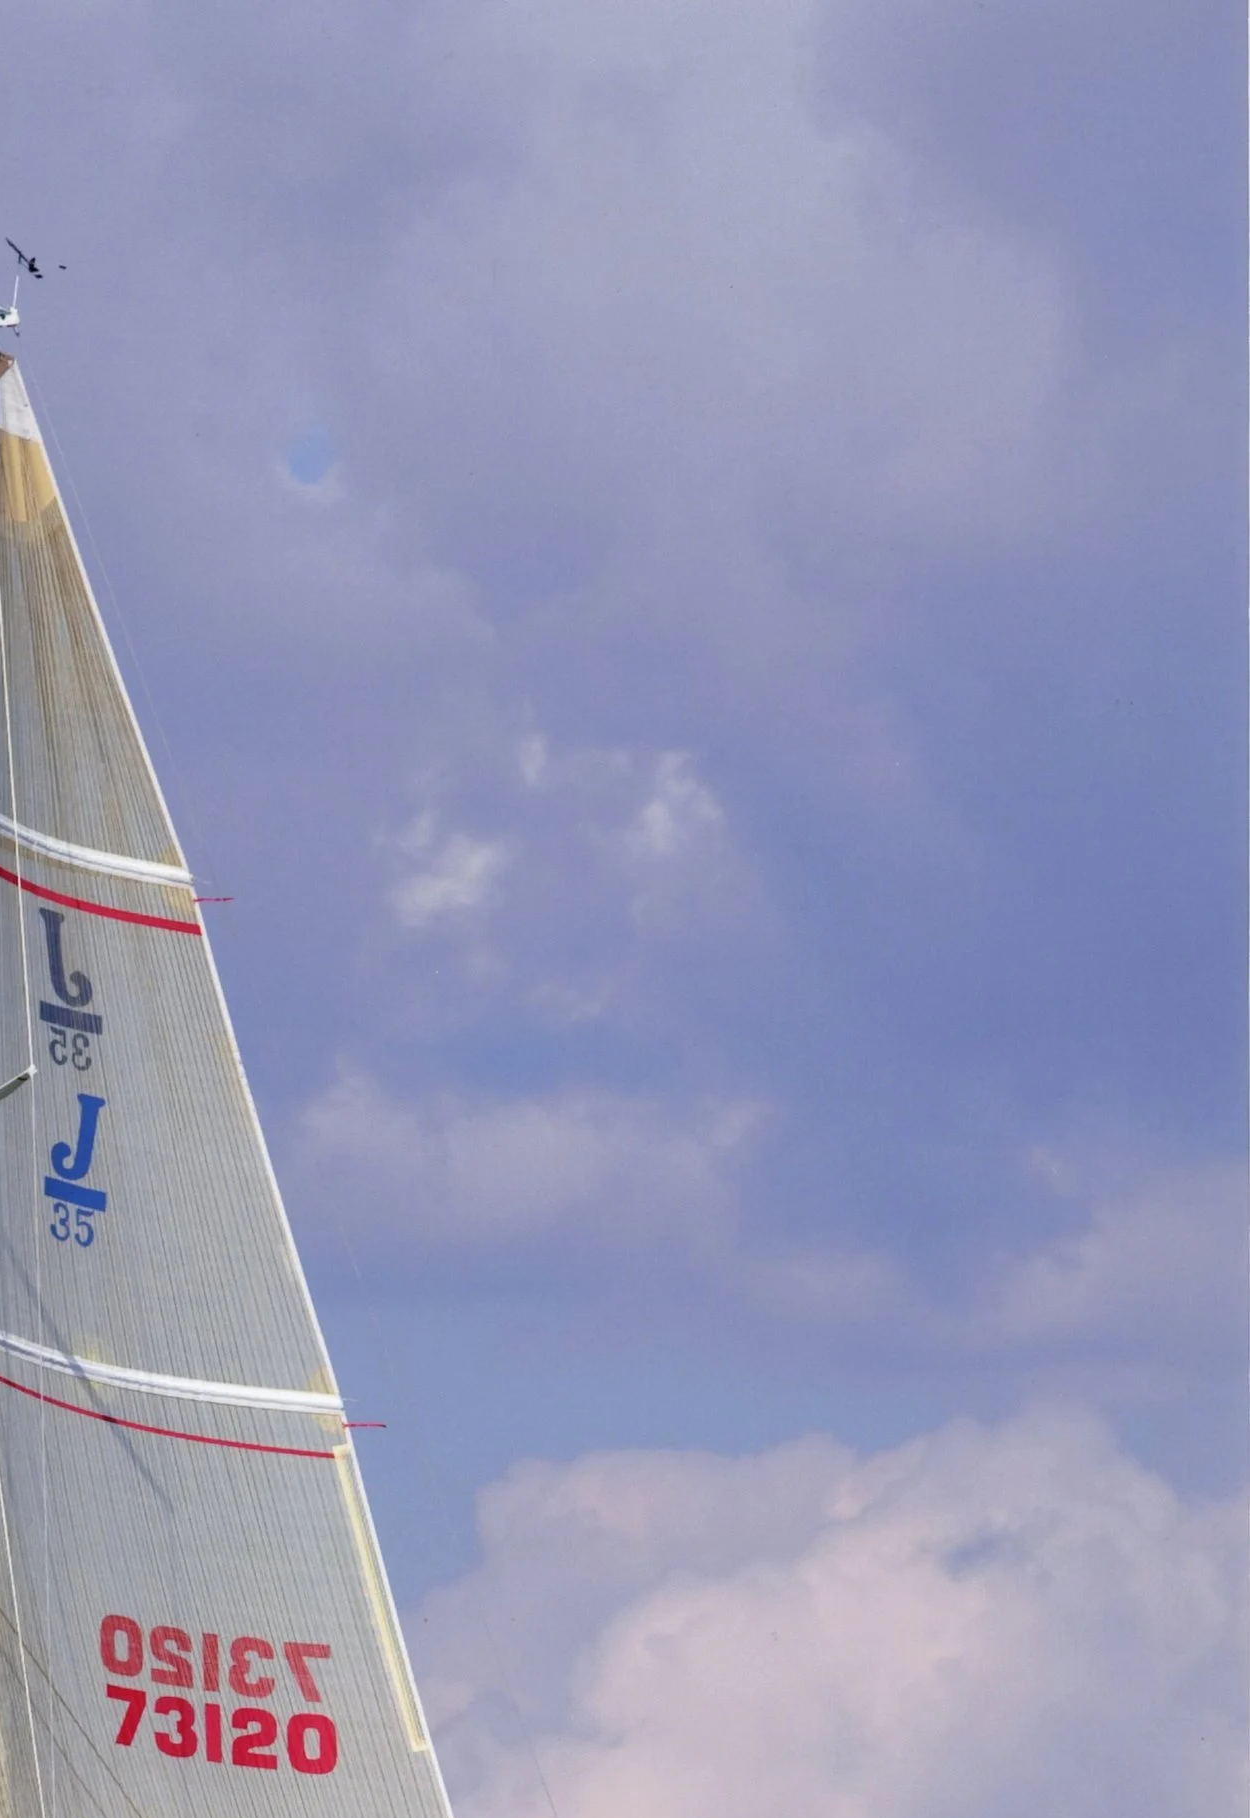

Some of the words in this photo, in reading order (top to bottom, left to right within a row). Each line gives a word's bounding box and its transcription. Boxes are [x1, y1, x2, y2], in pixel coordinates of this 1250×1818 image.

[51, 1093, 106, 1180] J
[50, 1202, 94, 1248] 35
[106, 1683, 338, 1775] 73120
